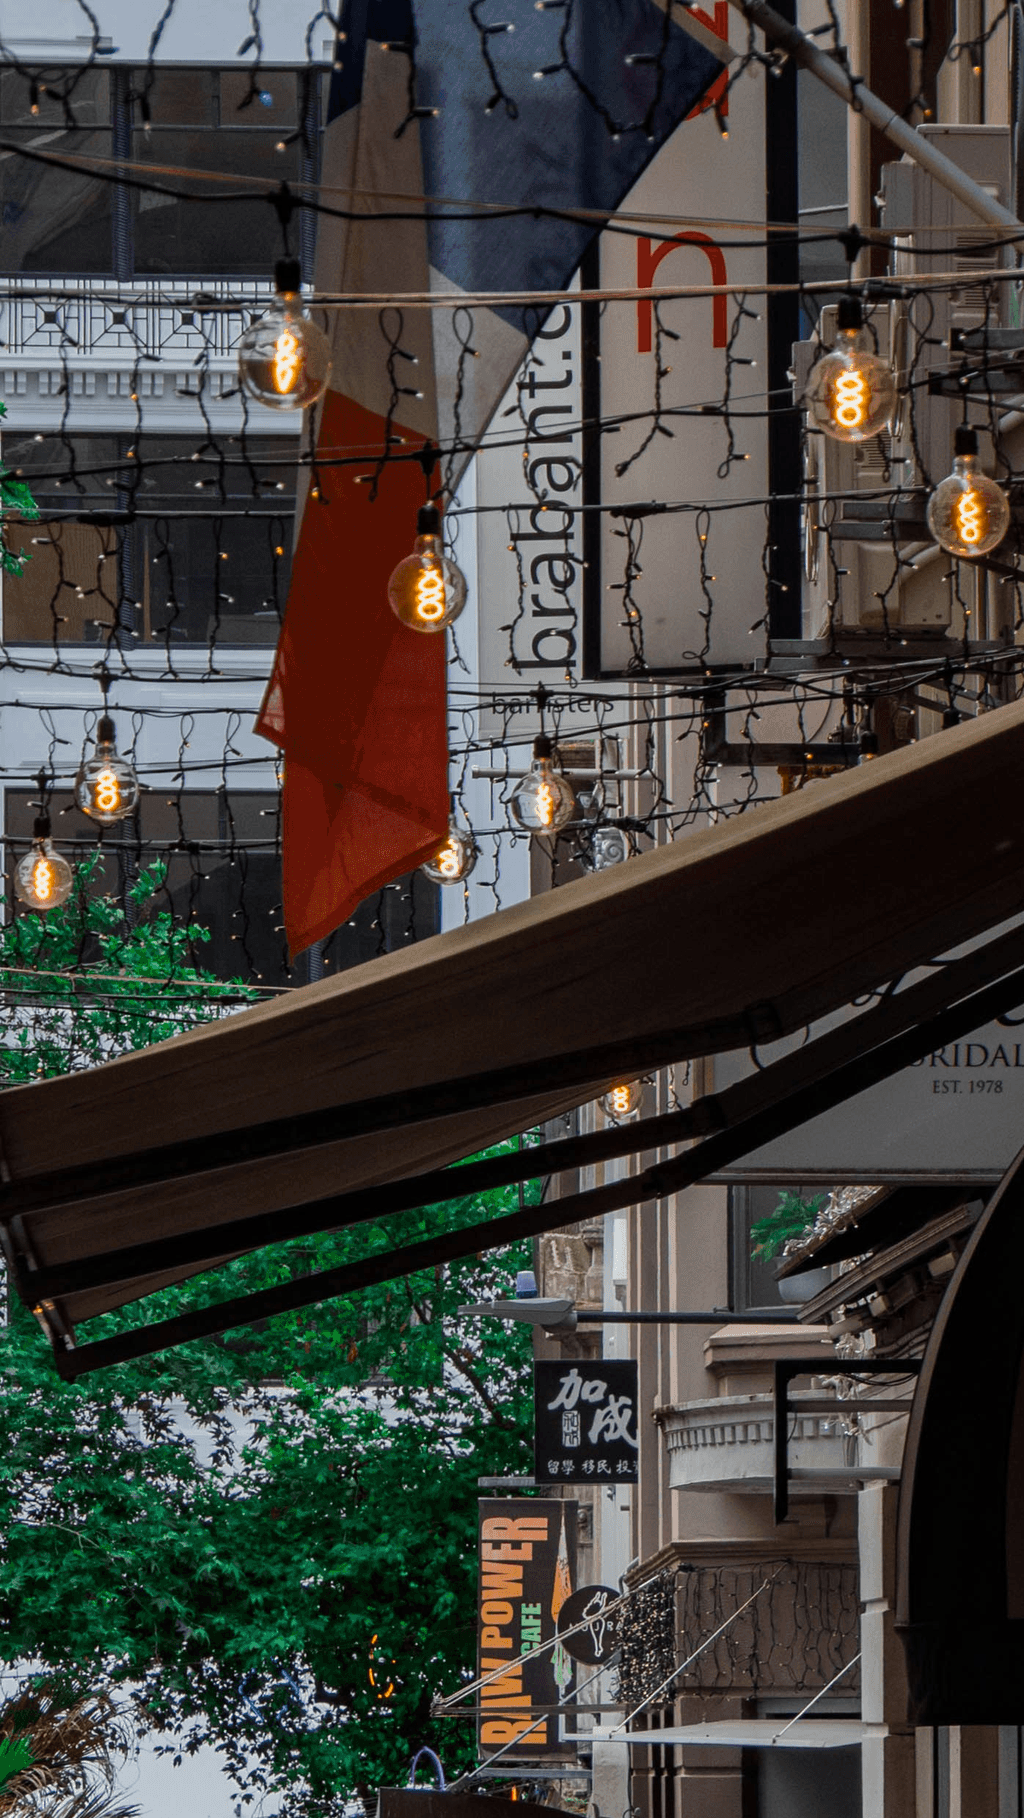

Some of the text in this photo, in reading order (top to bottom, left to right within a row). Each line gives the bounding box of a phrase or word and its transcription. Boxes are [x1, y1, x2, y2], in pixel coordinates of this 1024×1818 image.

[932, 1080, 1004, 1094] EST. 1978
[547, 1459, 575, 1475] 留學
[581, 1459, 611, 1475] 移民
[480, 1517, 548, 1744] RAW POWER
[520, 1603, 541, 1657] CAFE
